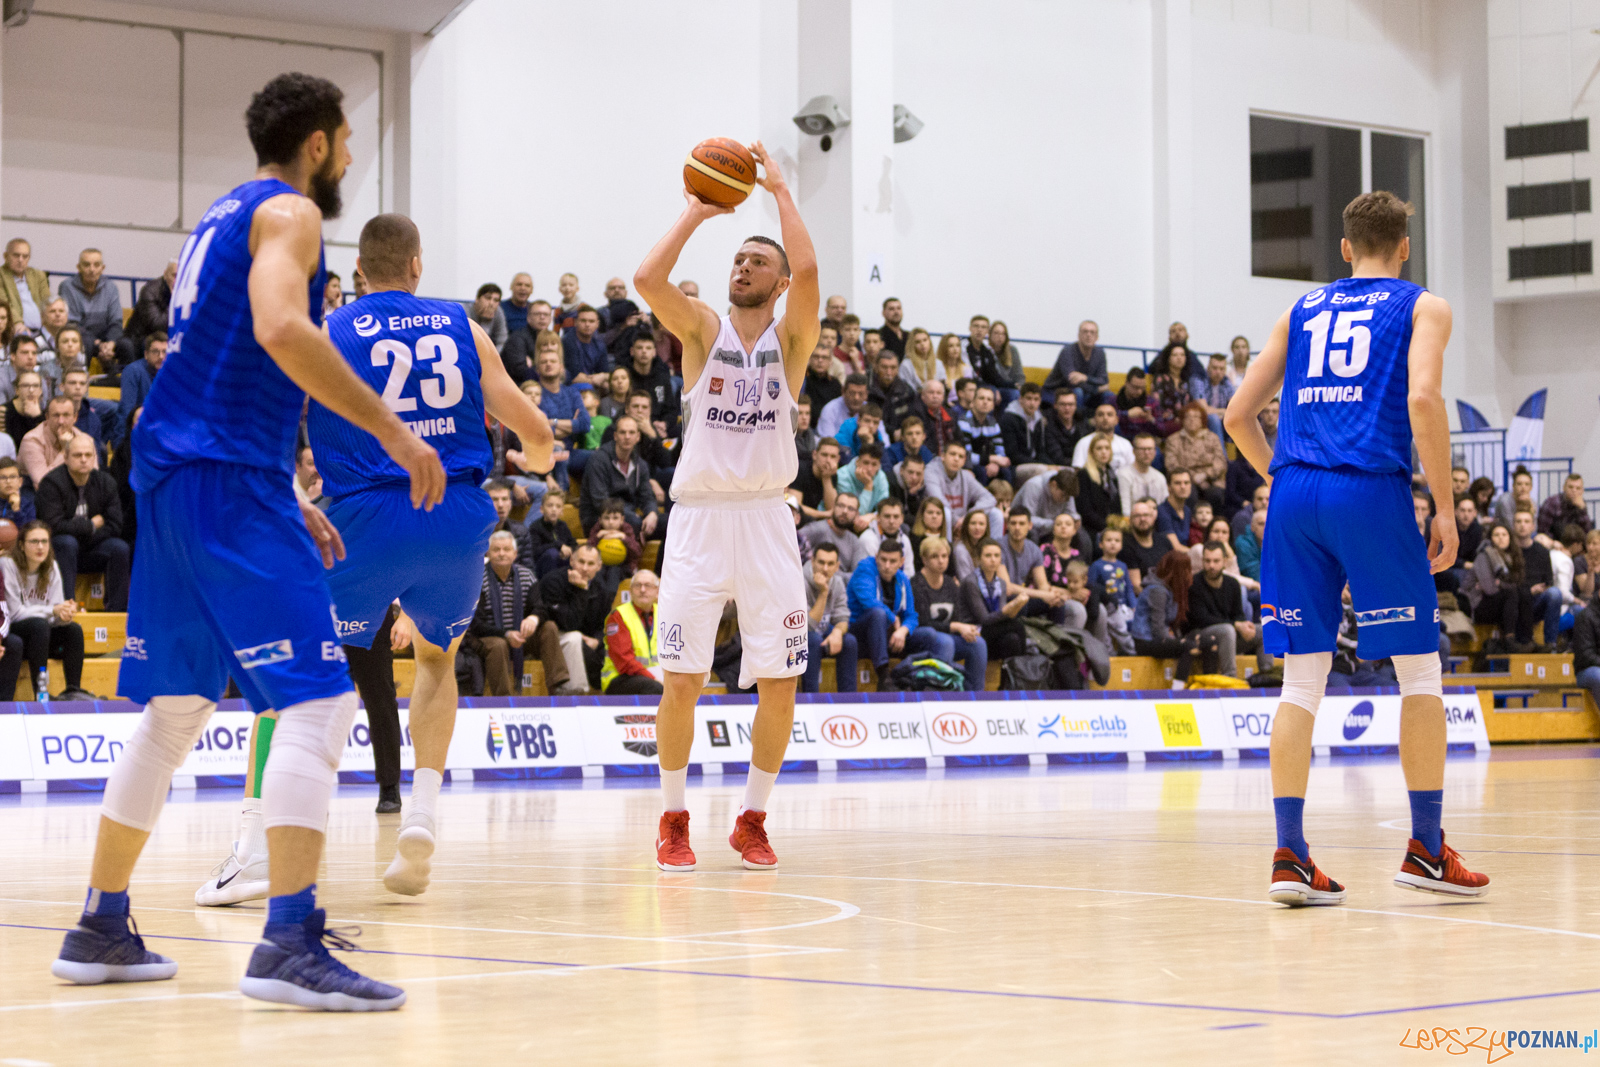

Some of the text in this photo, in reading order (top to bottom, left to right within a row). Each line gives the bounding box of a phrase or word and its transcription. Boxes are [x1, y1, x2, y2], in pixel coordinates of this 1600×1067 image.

[705, 150, 745, 175] molten
[869, 264, 882, 282] A
[1330, 292, 1391, 306] Energa
[388, 314, 452, 330] Energa
[1302, 309, 1374, 378] 15
[370, 334, 464, 413] 23
[733, 378, 761, 407] 14
[404, 416, 457, 438] TWICA
[725, 425, 756, 435] PRODUCE
[660, 621, 685, 652] 14
[501, 713, 551, 722] fundacja
[1061, 715, 1127, 731] funclub
[624, 727, 657, 740] JOKE
[829, 721, 922, 740] KIA DELIK
[940, 719, 1028, 737] KIA DELIK
[504, 723, 557, 760] PBG
